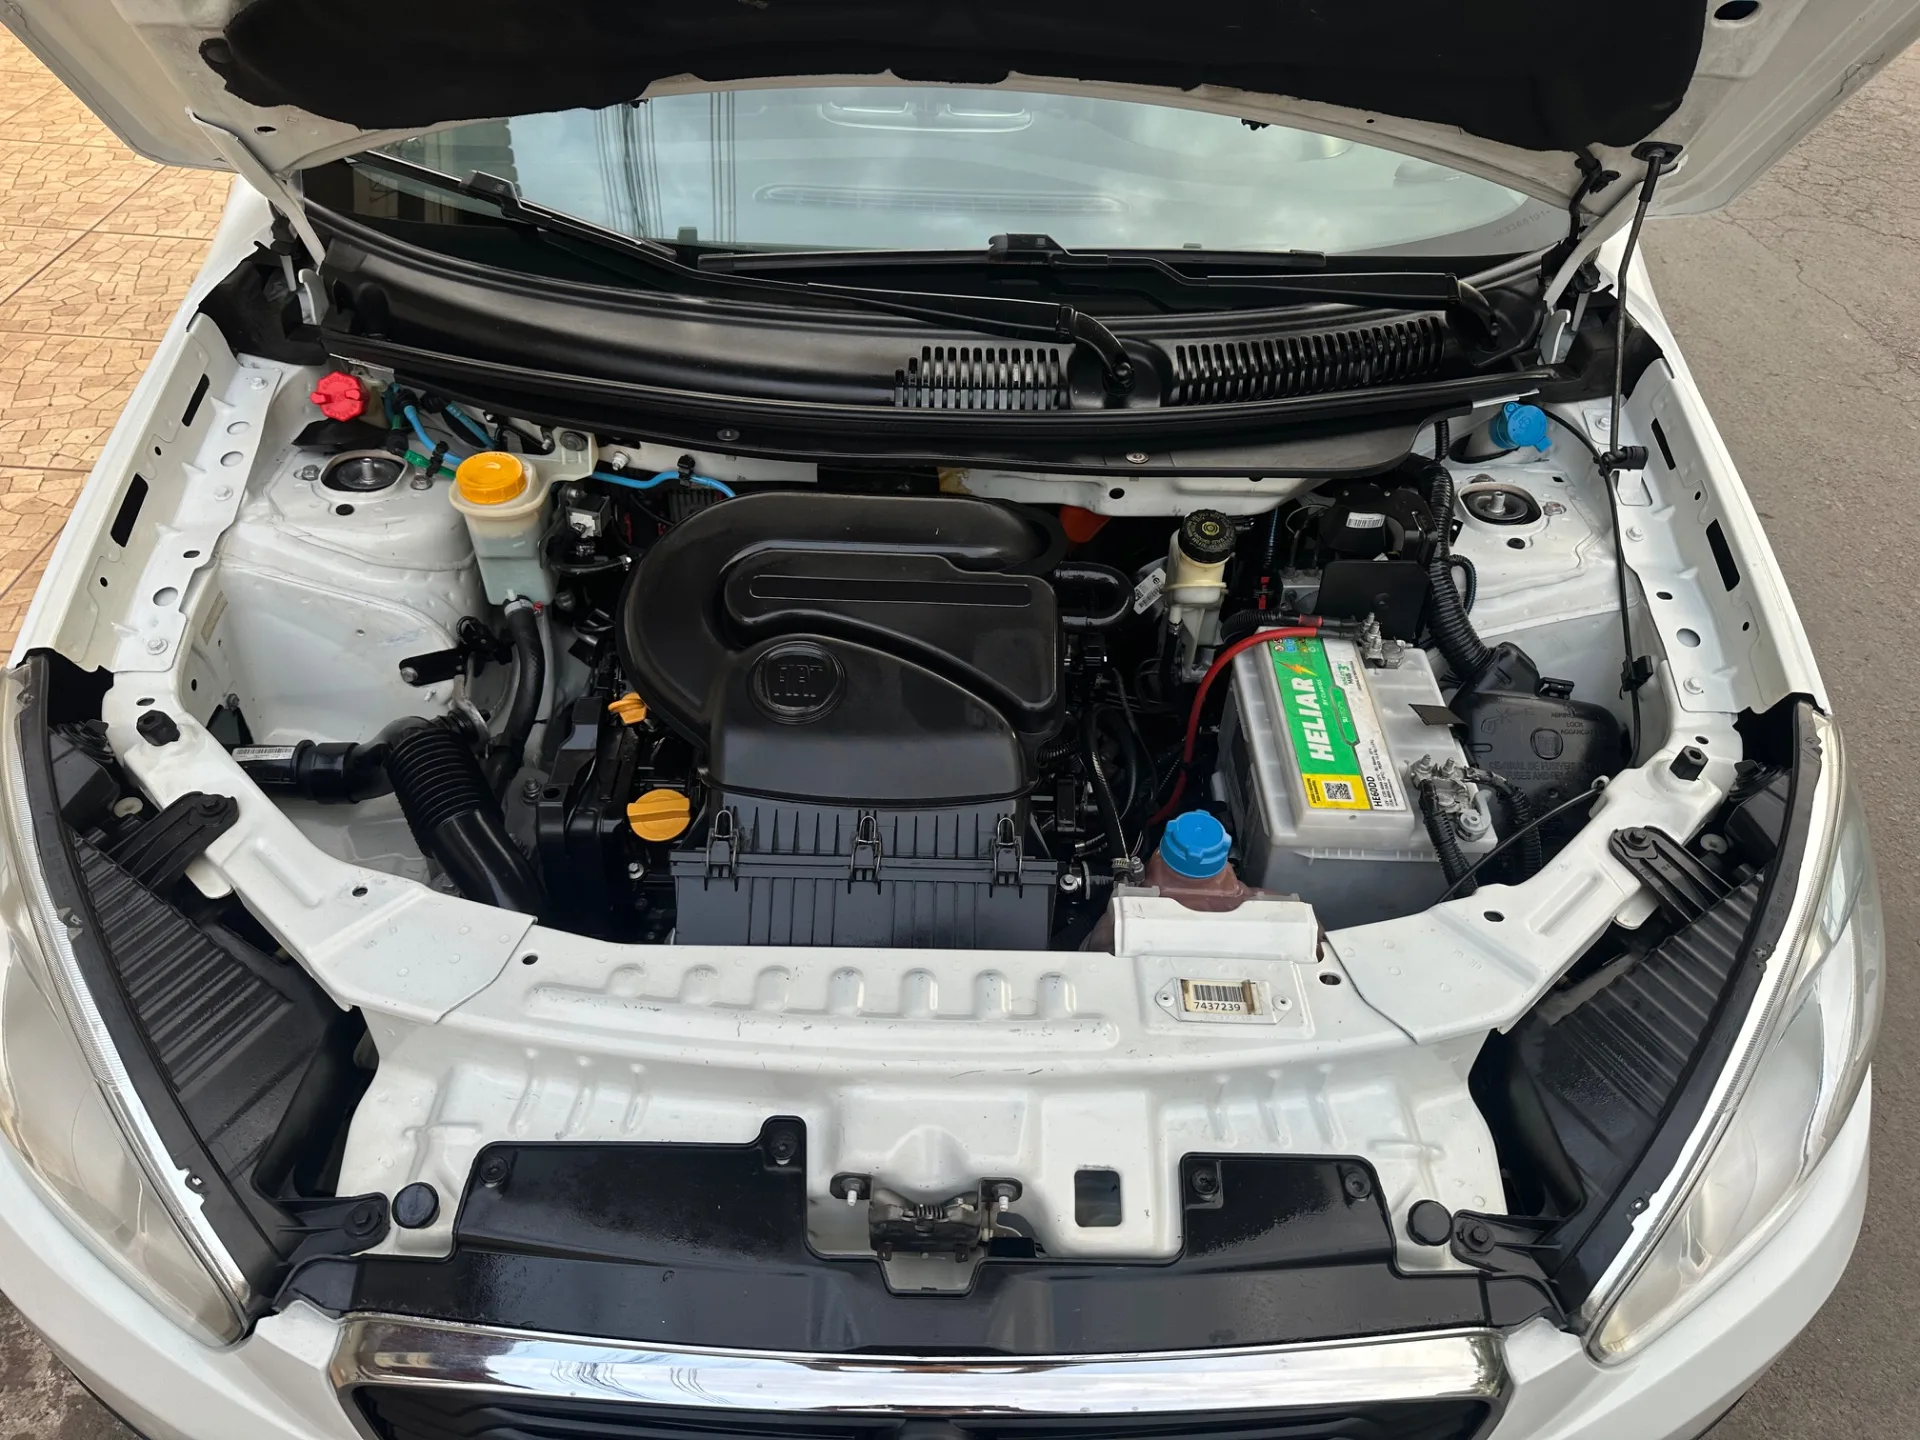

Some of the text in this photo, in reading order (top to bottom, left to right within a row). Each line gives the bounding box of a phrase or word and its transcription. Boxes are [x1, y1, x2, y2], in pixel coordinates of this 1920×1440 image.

[1291, 677, 1335, 762] HELIAR
[1365, 775, 1383, 807] HE60DD
[1193, 1001, 1241, 1012] 7437239
